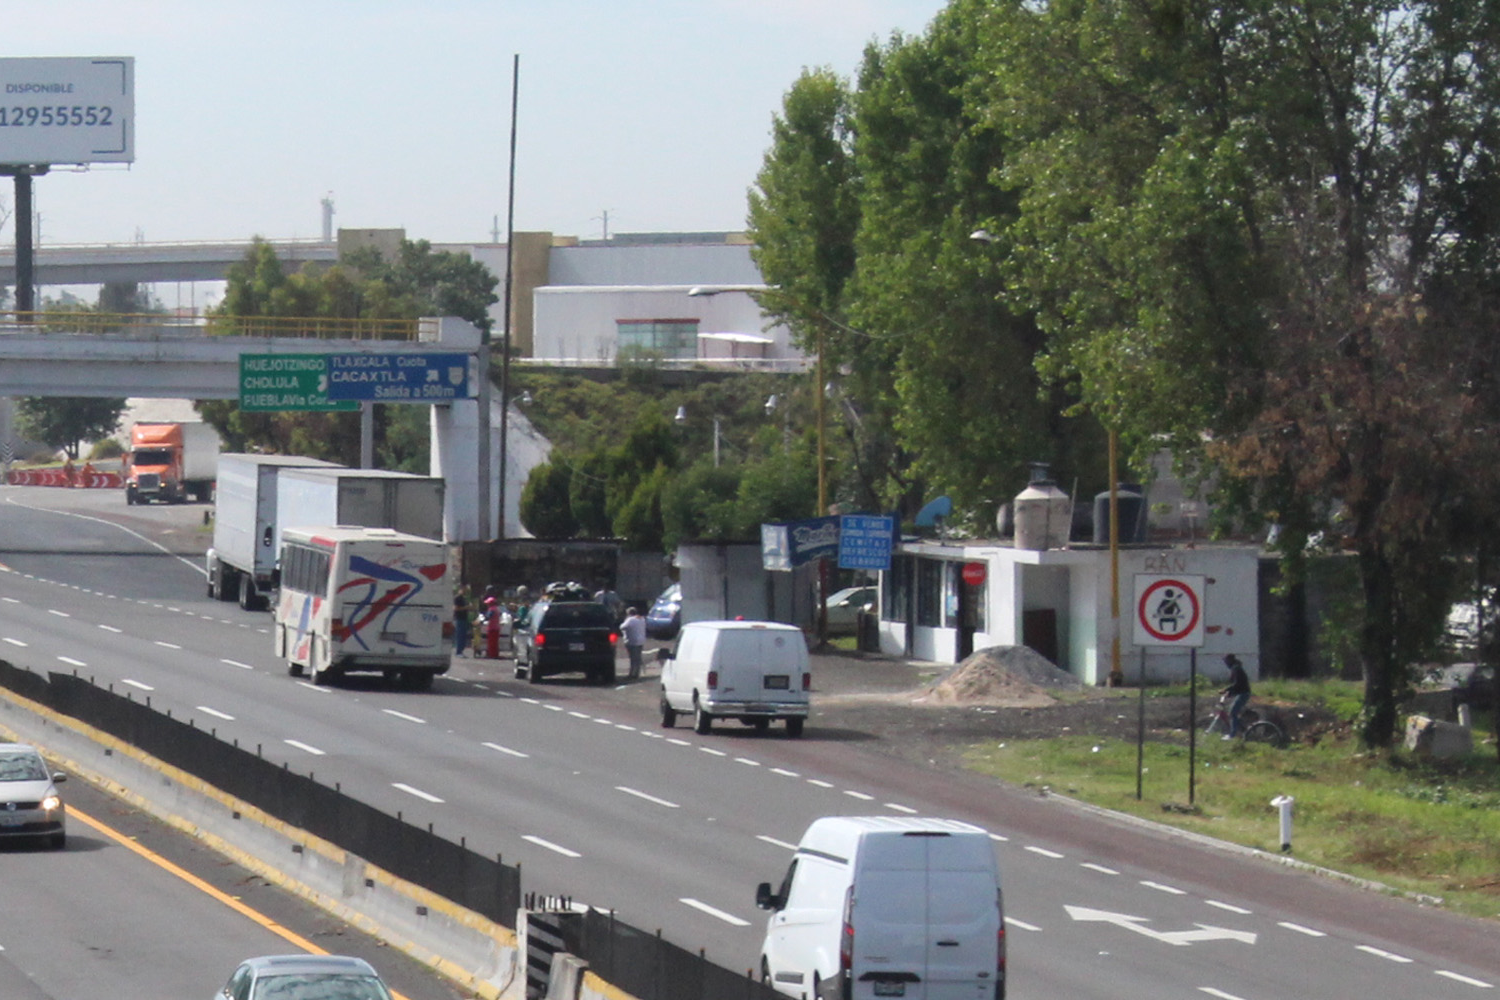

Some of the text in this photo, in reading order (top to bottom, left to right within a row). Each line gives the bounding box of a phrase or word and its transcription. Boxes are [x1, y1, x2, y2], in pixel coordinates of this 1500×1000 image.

[6, 83, 74, 94] DISPONIBLE
[244, 359, 325, 371] HUEJOTZINGO
[332, 357, 427, 367] TLAXCALA Cuota
[331, 371, 407, 382] CACAXTLA
[244, 376, 299, 389] CHOLULA
[374, 386, 410, 398] Salida
[414, 388, 420, 397] a
